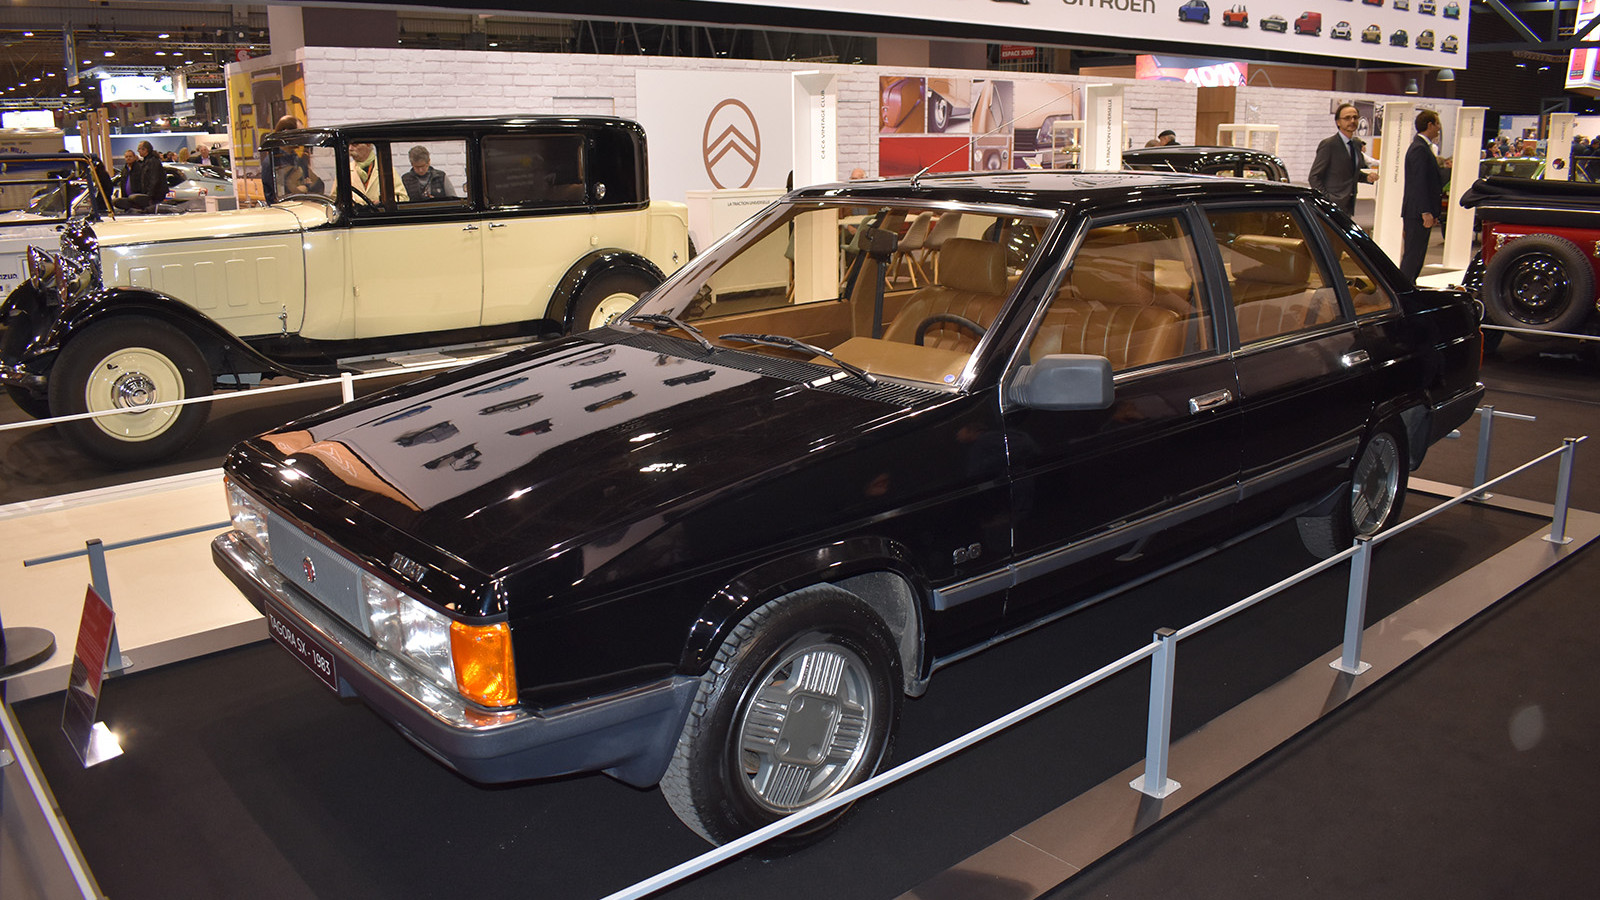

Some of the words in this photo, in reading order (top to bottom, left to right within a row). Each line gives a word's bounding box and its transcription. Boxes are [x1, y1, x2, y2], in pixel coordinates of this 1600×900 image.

[269, 613, 298, 648] TAGORA
[296, 637, 308, 656] SX
[312, 649, 331, 676] 1983
